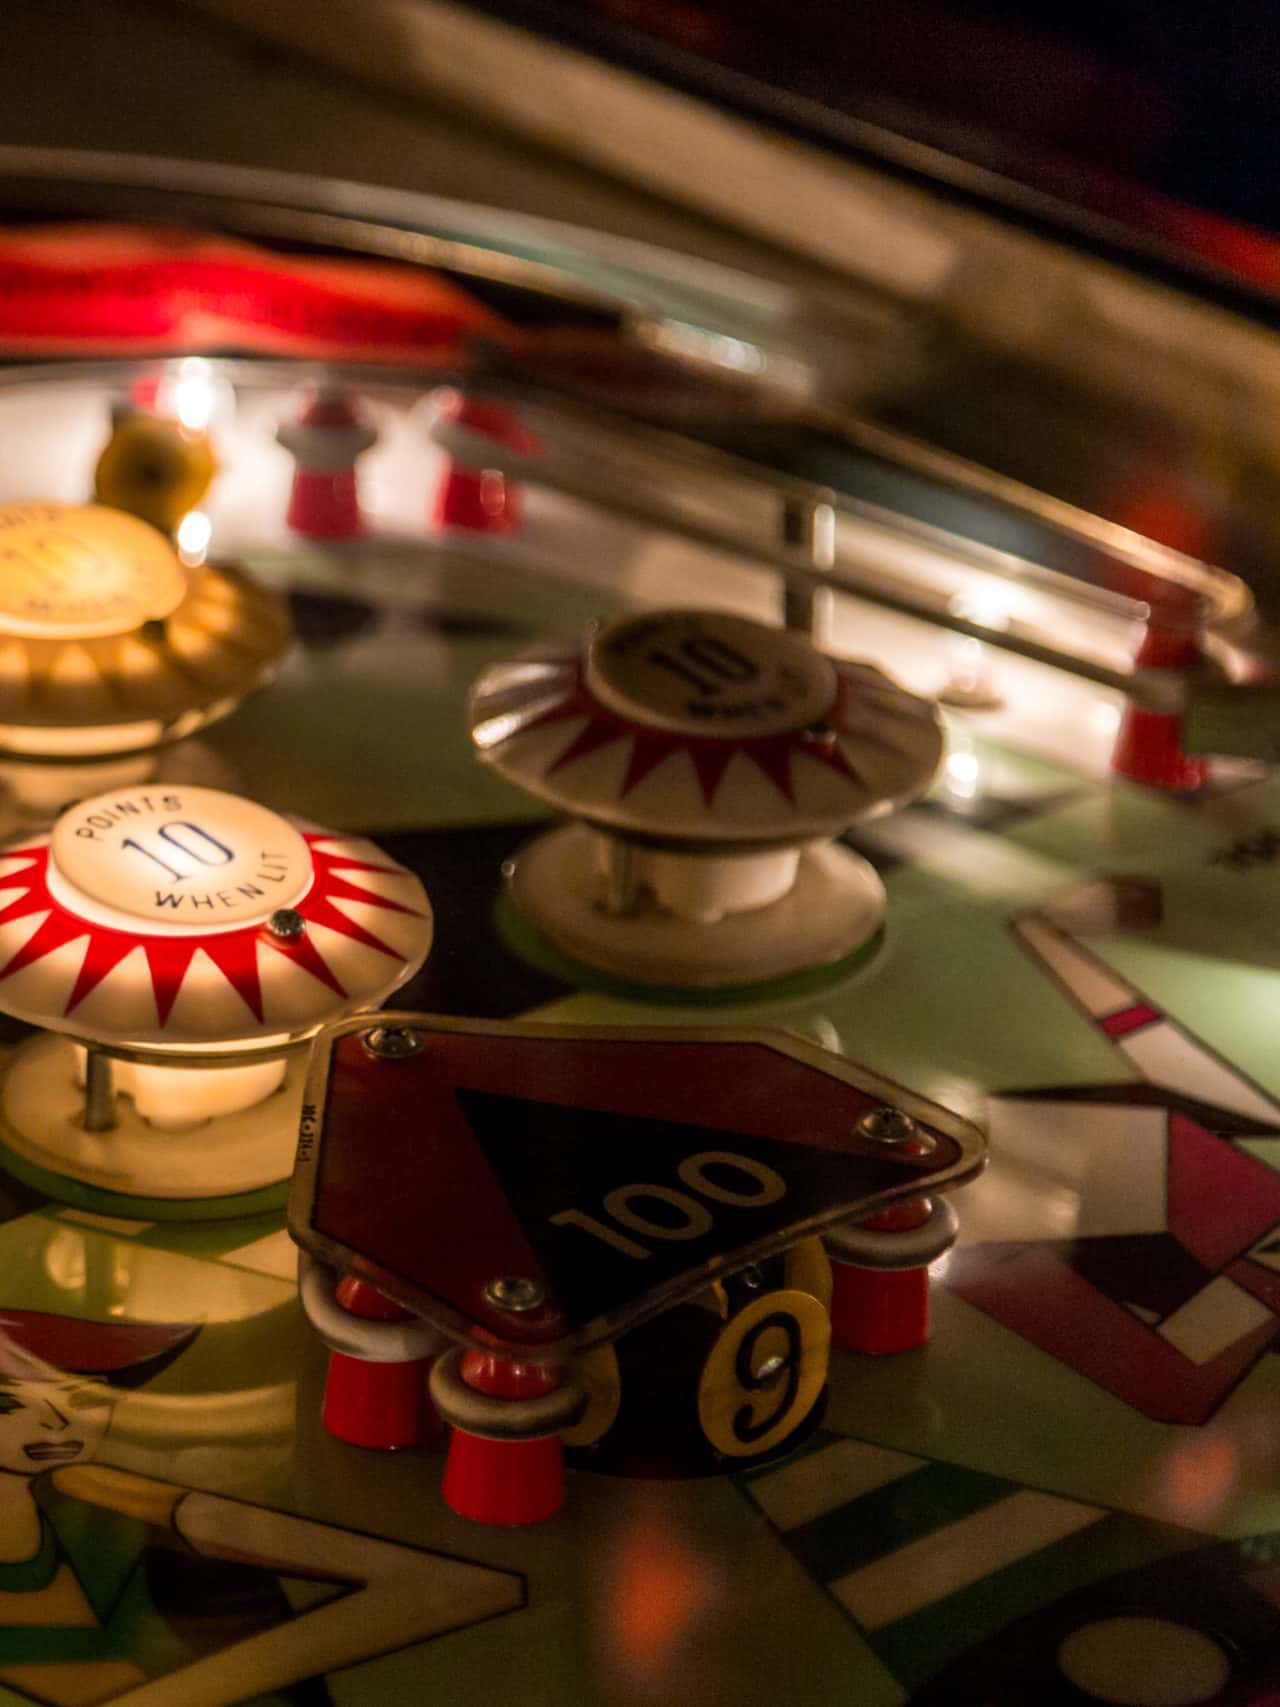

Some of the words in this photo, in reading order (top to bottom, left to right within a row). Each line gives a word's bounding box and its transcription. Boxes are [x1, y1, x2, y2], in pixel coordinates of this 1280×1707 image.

[647, 639, 759, 698] 10
[75, 795, 183, 841] POINTS
[121, 820, 235, 883] 10
[155, 883, 265, 910] WHEN
[256, 851, 289, 884] LIT
[548, 1150, 788, 1261] 100
[732, 1311, 803, 1444] 9
